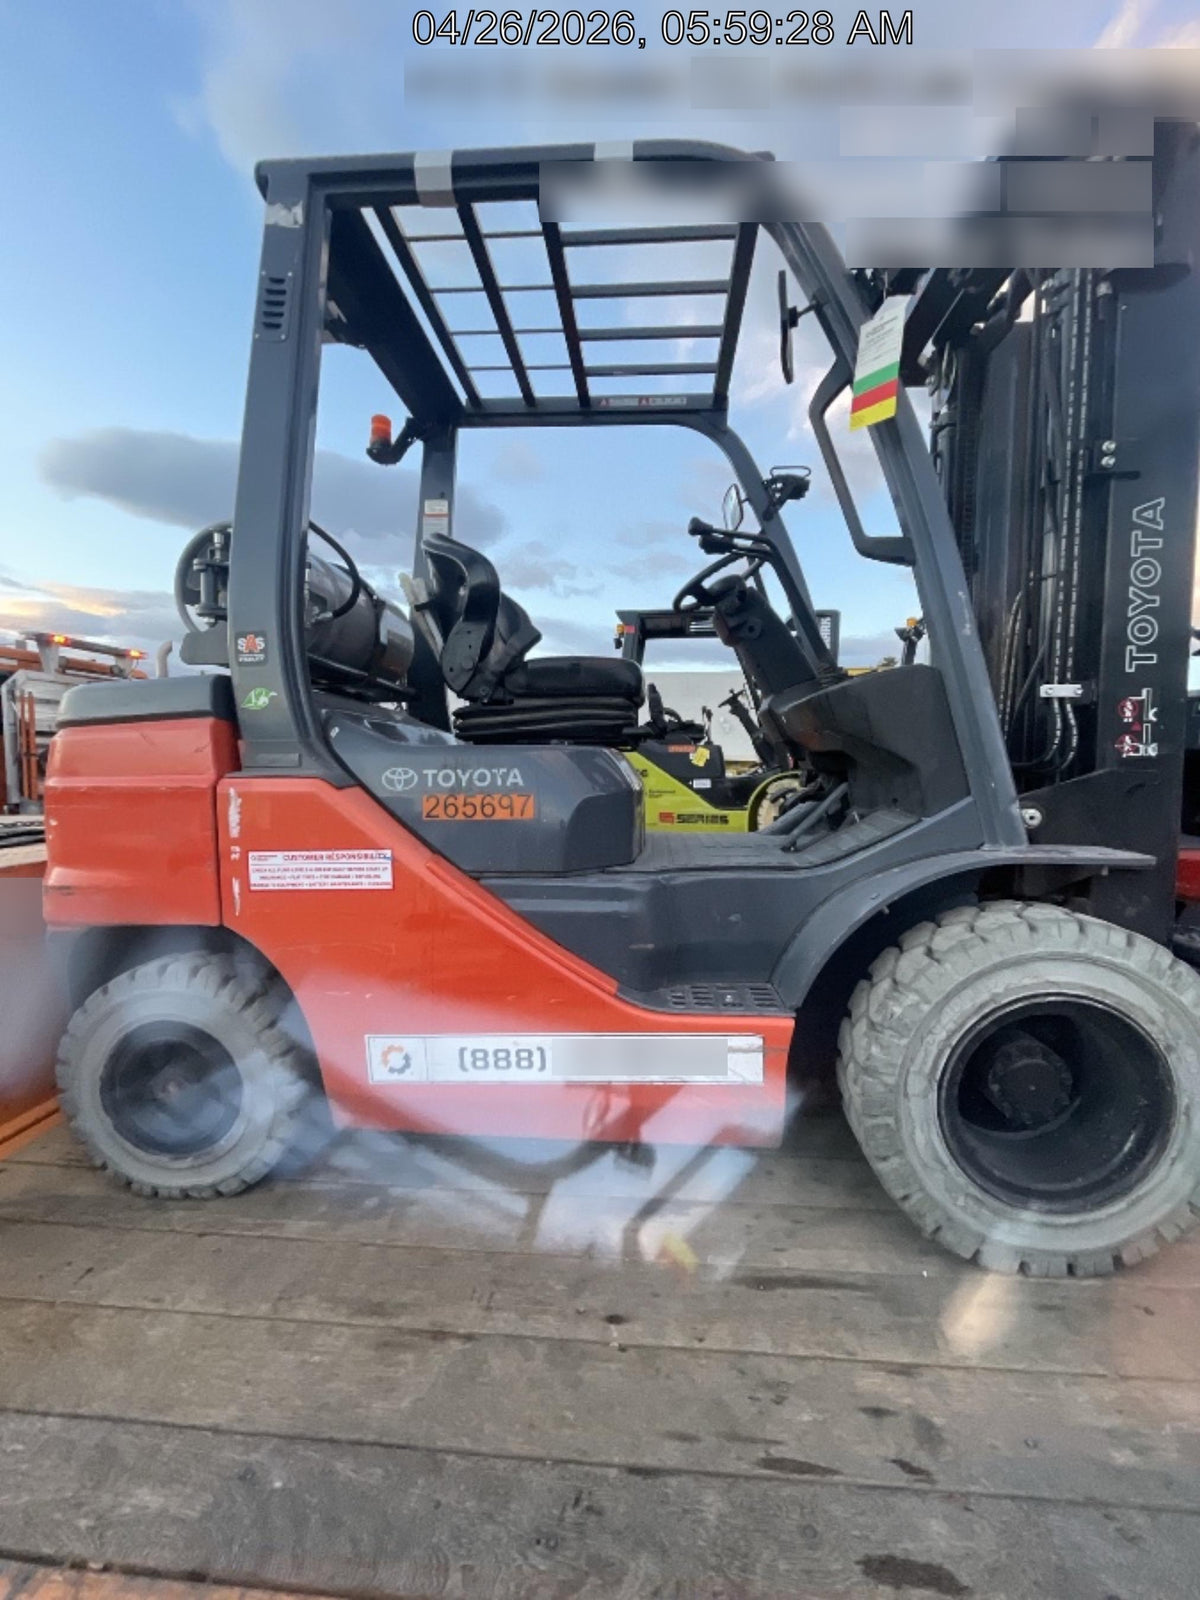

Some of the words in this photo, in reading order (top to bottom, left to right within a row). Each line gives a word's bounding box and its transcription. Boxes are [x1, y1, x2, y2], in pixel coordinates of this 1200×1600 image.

[1125, 496, 1165, 673] TOYOTA
[237, 632, 266, 654] SAS
[422, 767, 525, 788] TOYOTA
[423, 794, 532, 819] 265697
[677, 813, 729, 825] SERIES
[457, 1045, 547, 1073] (888)
